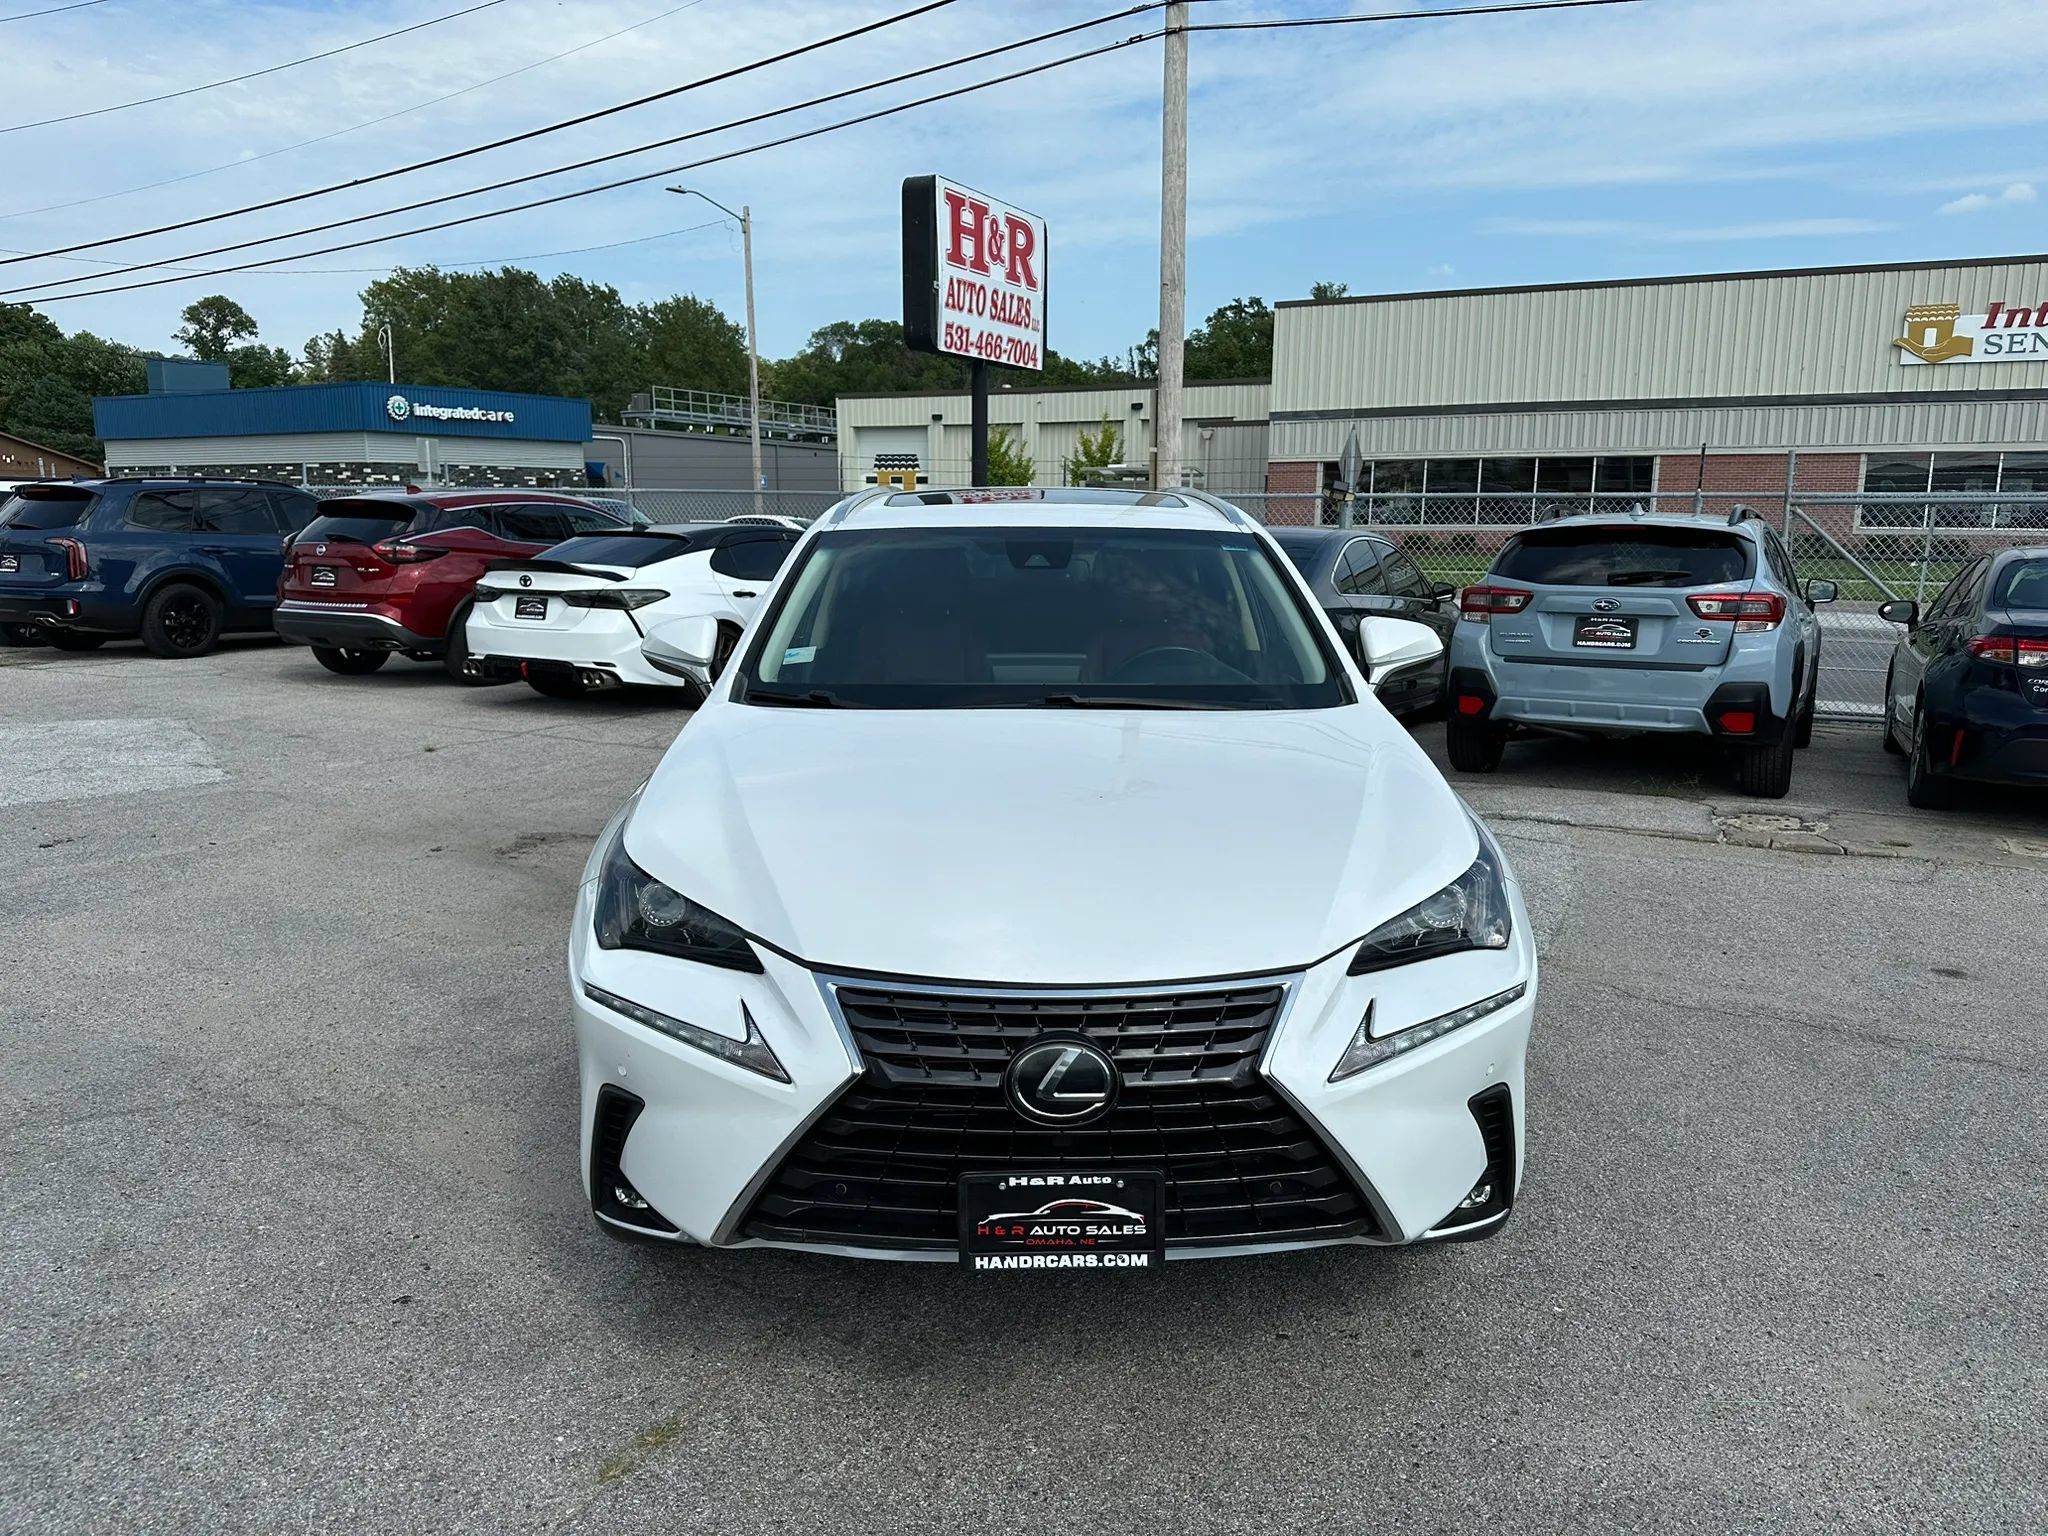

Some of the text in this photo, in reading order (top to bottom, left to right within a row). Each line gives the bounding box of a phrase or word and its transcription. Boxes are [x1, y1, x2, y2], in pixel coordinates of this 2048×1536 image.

[944, 187, 1038, 292] H&R
[945, 276, 986, 316] AUTO
[989, 288, 1031, 331] SALES
[1980, 302, 2048, 329] Int
[944, 321, 1038, 368] 531-466-7004
[1984, 332, 2048, 355] SEN
[412, 402, 515, 422] integratedcare
[1008, 1175, 1112, 1187] H&R Auto
[977, 1225, 990, 1235] H
[1011, 1226, 1025, 1235] R
[1030, 1225, 1081, 1235] AUTO
[1085, 1224, 1147, 1235] SALES
[1025, 1238, 1096, 1246] OMAHA, NE
[975, 1253, 1149, 1270] HANDRCARS.COM
